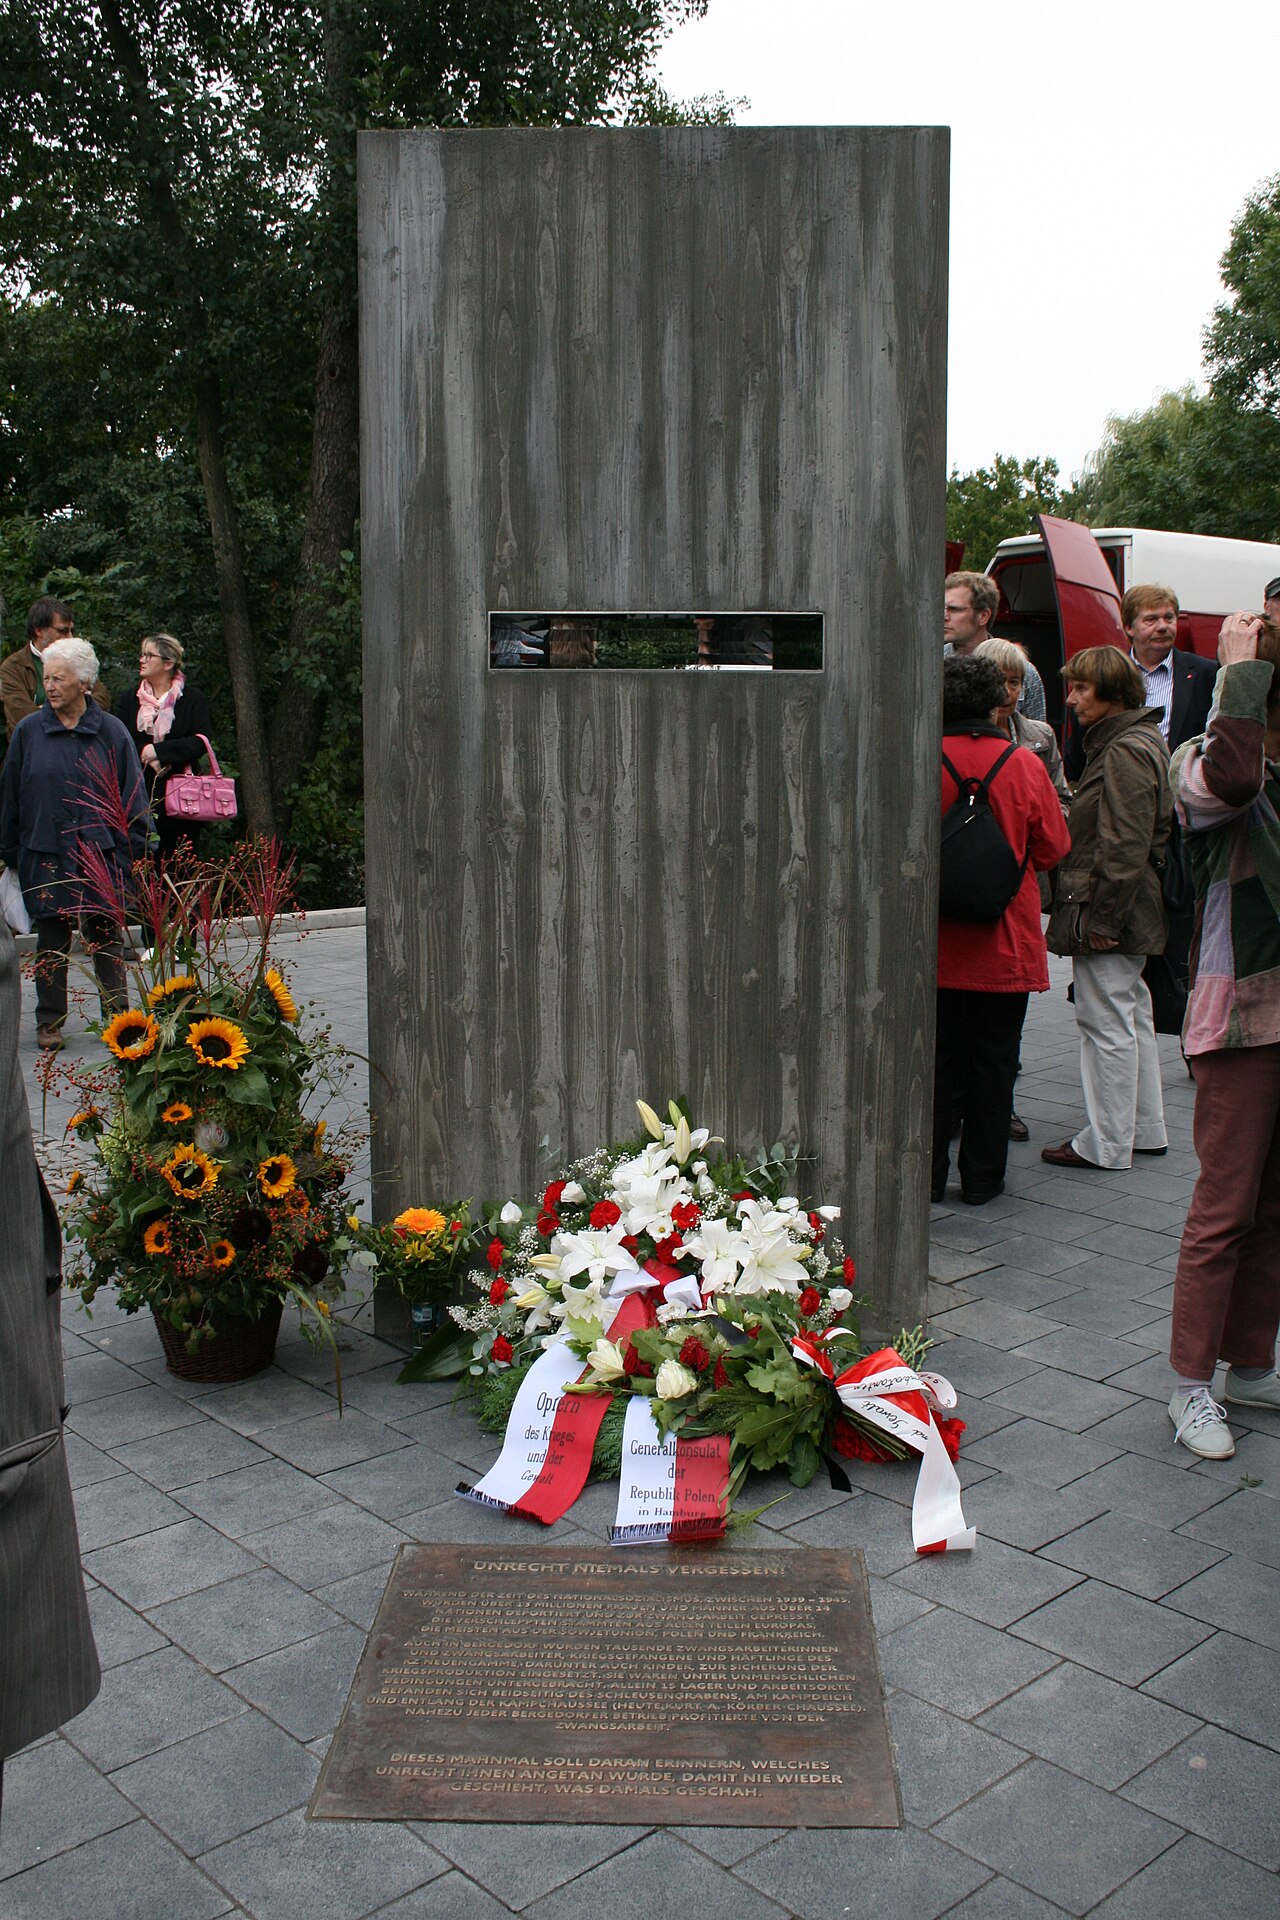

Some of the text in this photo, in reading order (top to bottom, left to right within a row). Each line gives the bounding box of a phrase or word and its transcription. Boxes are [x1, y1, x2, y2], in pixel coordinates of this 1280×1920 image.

[537, 1392, 580, 1417] Opfern
[525, 1425, 576, 1447] des Krieges
[912, 1429, 928, 1441] nd
[630, 1439, 721, 1459] Generalkonsulat
[527, 1449, 564, 1465] und der
[521, 1470, 554, 1484] Gewalt
[668, 1462, 686, 1479] der
[630, 1485, 714, 1503] Republik Polen
[638, 1506, 706, 1518] in Hamburg
[473, 1561, 785, 1576] UNRECHT NIEMALS VERGESSEN!
[422, 1599, 476, 1607] WURDEN
[481, 1599, 512, 1607] ÜBER
[534, 1601, 602, 1610] MILLIONEN
[780, 1604, 812, 1612] ÜBER
[706, 1595, 772, 1603] ZWISCHEN
[435, 1608, 502, 1616] NATIONEN
[421, 1625, 440, 1633] DIE
[445, 1626, 498, 1634] MEISTEN
[532, 1627, 556, 1635] DER
[561, 1620, 631, 1628] STAMMTEN
[404, 1639, 440, 1647] AUCH
[463, 1641, 539, 1649] BERGEDORF
[605, 1644, 673, 1652] TAUSENDE
[570, 1652, 693, 1661] KRIEGSGEFANGENE
[731, 1653, 804, 1662] HÄFTLINGE
[807, 1654, 831, 1662] DES
[525, 1661, 597, 1669] DARUNTER
[643, 1663, 694, 1671] KINDER,
[730, 1663, 806, 1671] SICHERUNG
[382, 1668, 515, 1677] KRIEGSPRODUKTION
[521, 1670, 601, 1679] EINGESETZT.
[606, 1671, 624, 1679] SIE
[629, 1672, 677, 1680] WAREN
[731, 1673, 856, 1681] UNMENSCHLICHEN
[384, 1677, 482, 1686] BEDINGUNGEN
[680, 1682, 723, 1690] LAGER
[727, 1682, 757, 1691] UND
[762, 1682, 851, 1691] ARBEITSORTE
[381, 1686, 852, 1701] BEFANDEN SICH BEIDSEITIG DES SCHLEUSENGRABENS, AM KAMPDEICH
[368, 1696, 397, 1704] UND
[401, 1697, 464, 1706] ENTLANG
[469, 1698, 495, 1707] DER
[499, 1700, 607, 1709] KAMPCHAUSSEE
[405, 1707, 824, 1722] NAHEZU JEDER BERGEDORFER BETRIEB PROFITIERTE VON DER
[555, 1722, 669, 1731] ZWANGSARBEIT.
[390, 1753, 829, 1770] DIESES MAHNMAL SOLL DARAN ERINNERN, WELCHES
[376, 1766, 843, 1784] UNRECHT IHNEN ANGETAN WURDE, DAMIT NIE WIEDER
[450, 1781, 762, 1797] GESCHIEHT, WAS DAMALS GESCHAH.
